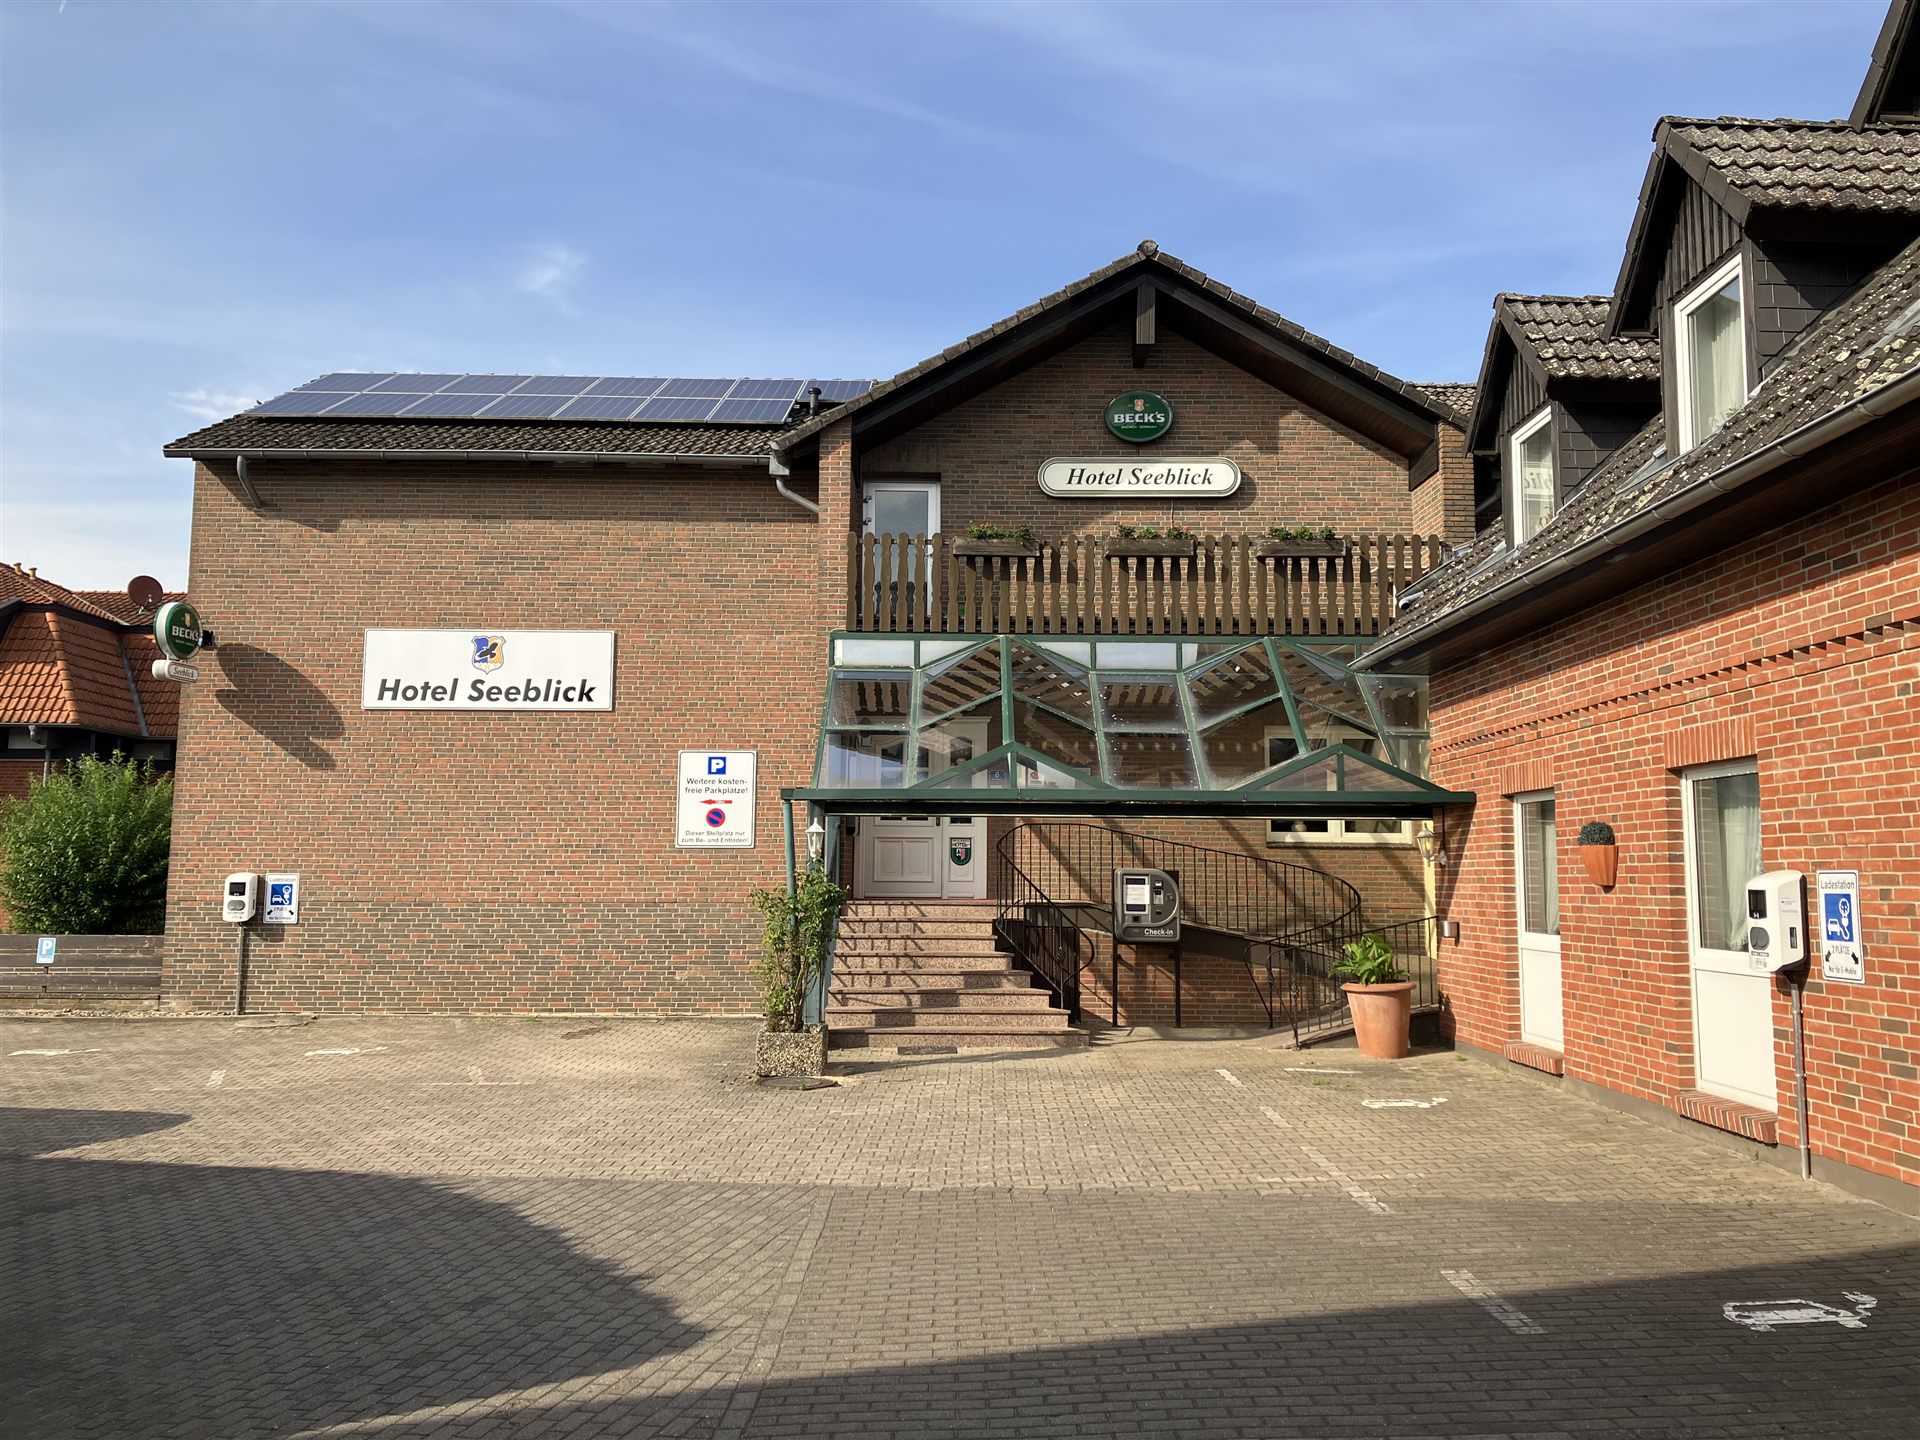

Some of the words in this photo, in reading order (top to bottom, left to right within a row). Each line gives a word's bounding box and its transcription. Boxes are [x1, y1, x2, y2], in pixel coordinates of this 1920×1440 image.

[1113, 411, 1165, 423] BECK'S
[1066, 467, 1123, 485] Hotel
[1127, 467, 1213, 485] Seeblick
[377, 677, 459, 702] Hotel
[467, 678, 597, 703] Seeblick
[1820, 879, 1855, 890] Ladestation
